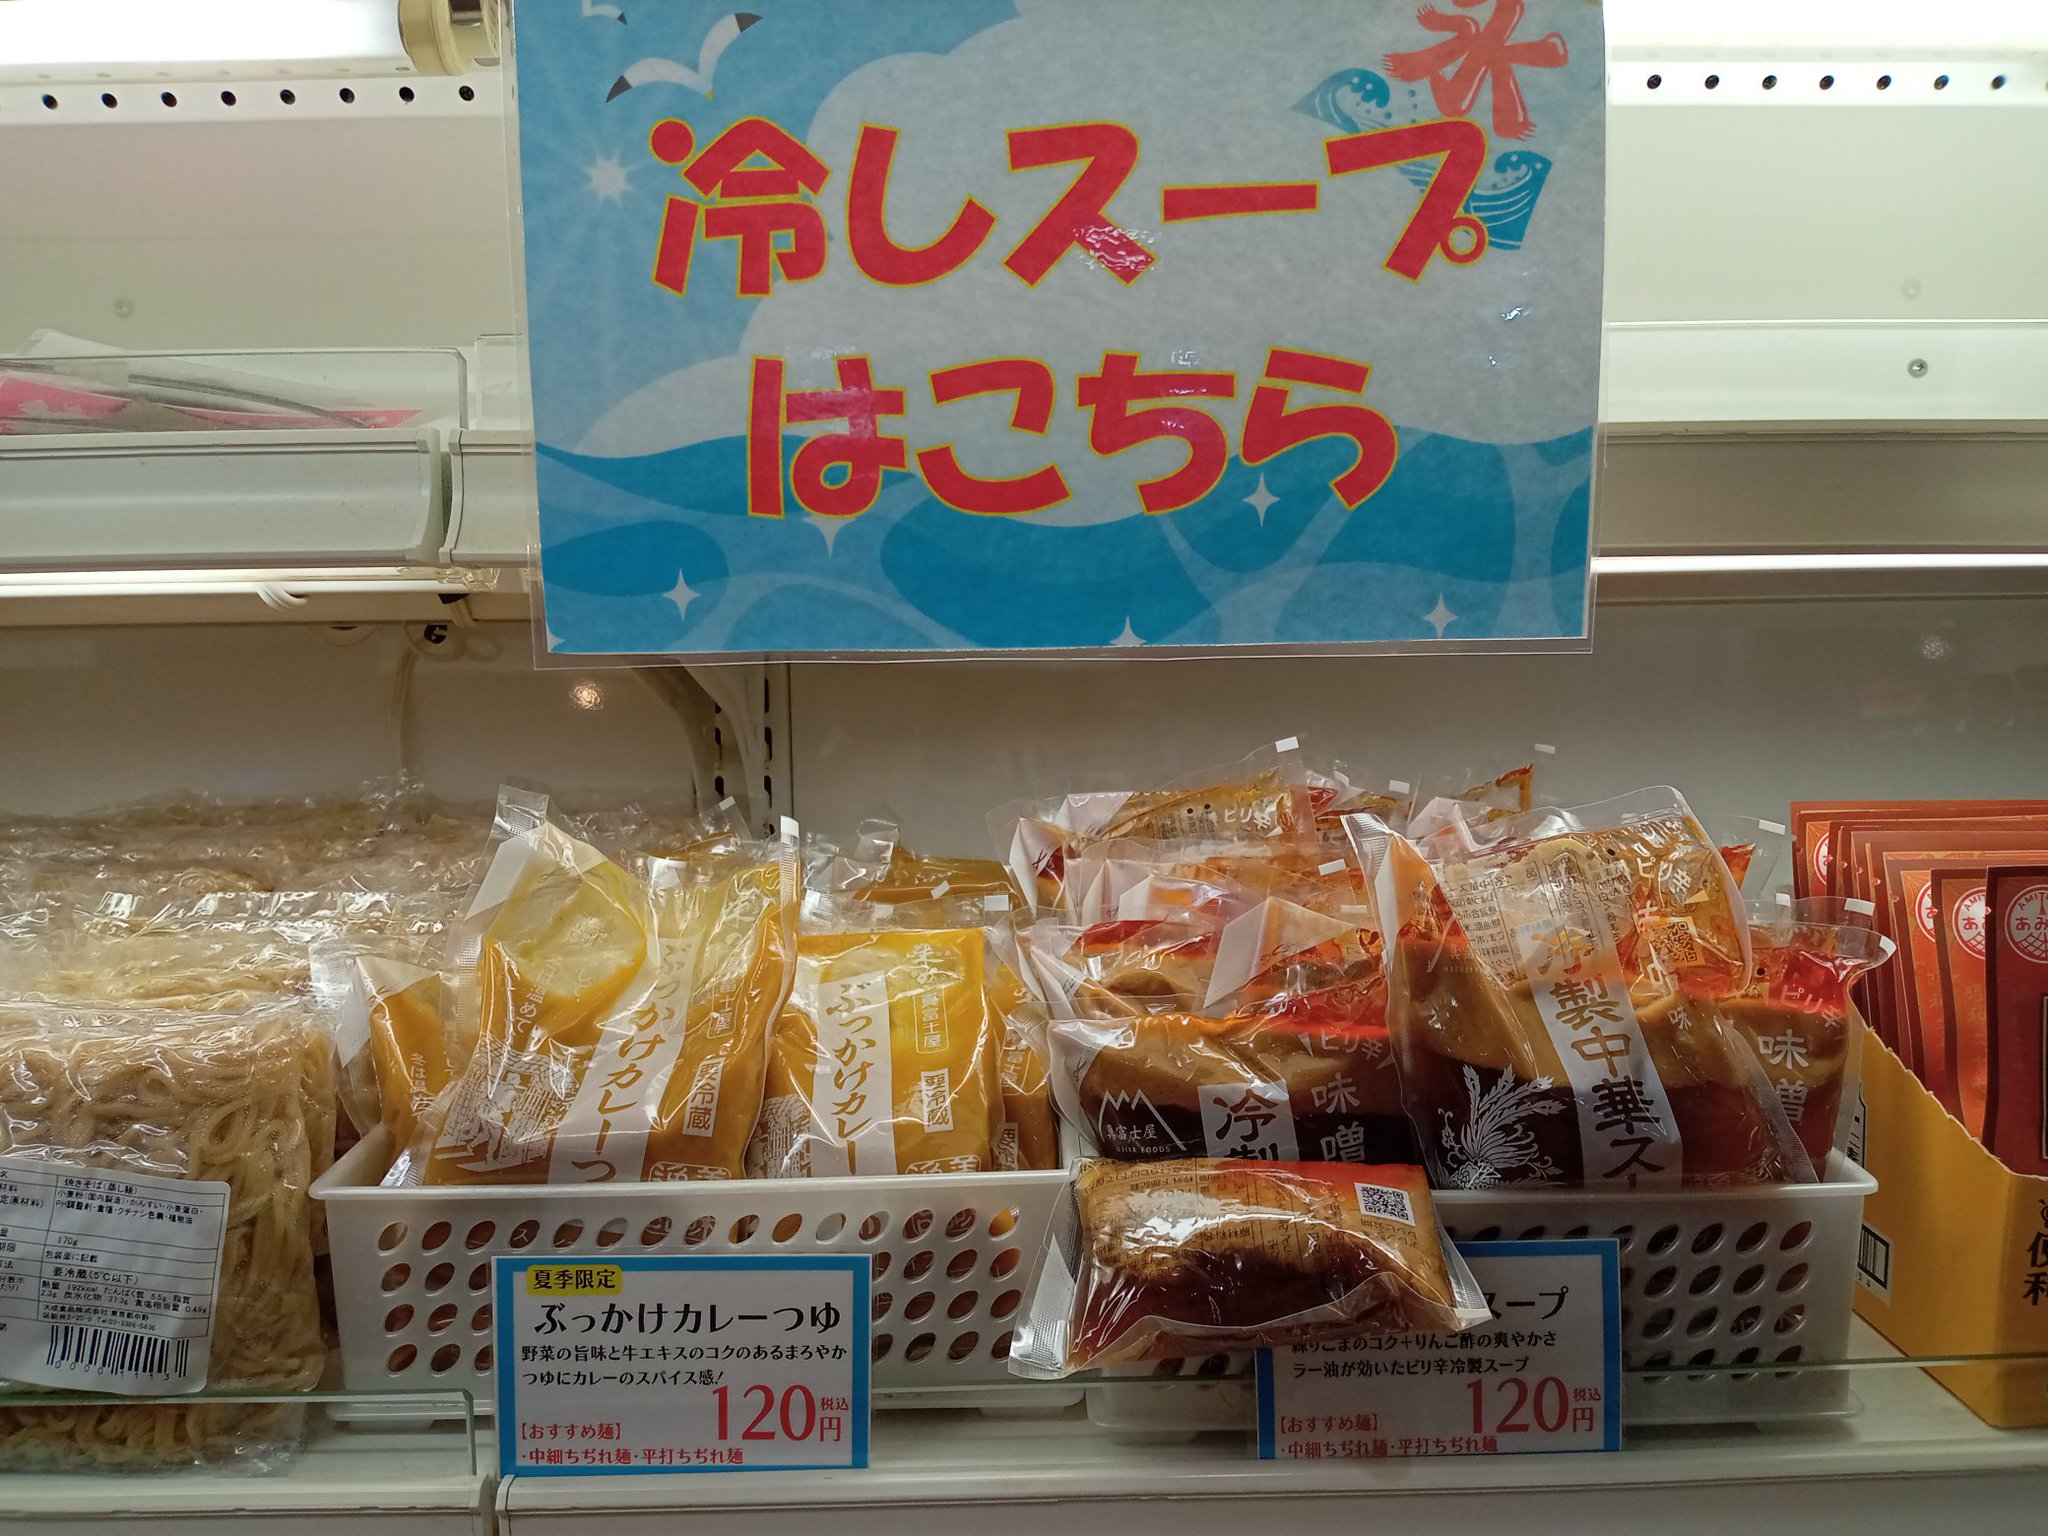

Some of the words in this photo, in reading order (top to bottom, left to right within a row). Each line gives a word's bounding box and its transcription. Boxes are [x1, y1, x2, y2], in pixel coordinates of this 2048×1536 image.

[648, 115, 1489, 298] 冷しスープ
[746, 346, 1398, 519] はこちら
[1106, 1123, 1158, 1141] 真富士屋
[1310, 1072, 1367, 1162] 味噌
[57, 1236, 78, 1247] 170g
[532, 1268, 617, 1290] 夏季限定
[534, 1301, 842, 1335] ぶっかけカレーつゆ
[521, 1344, 848, 1362] 野菜の旨味と牛エキスのコクのあるまろやか
[1292, 1355, 1530, 1379] ラー油が効いたピリ辛冷製スープ
[712, 1383, 817, 1442] 120
[819, 1397, 850, 1412] 税込
[1466, 1375, 1570, 1434] 120
[1572, 1387, 1601, 1402] 税込
